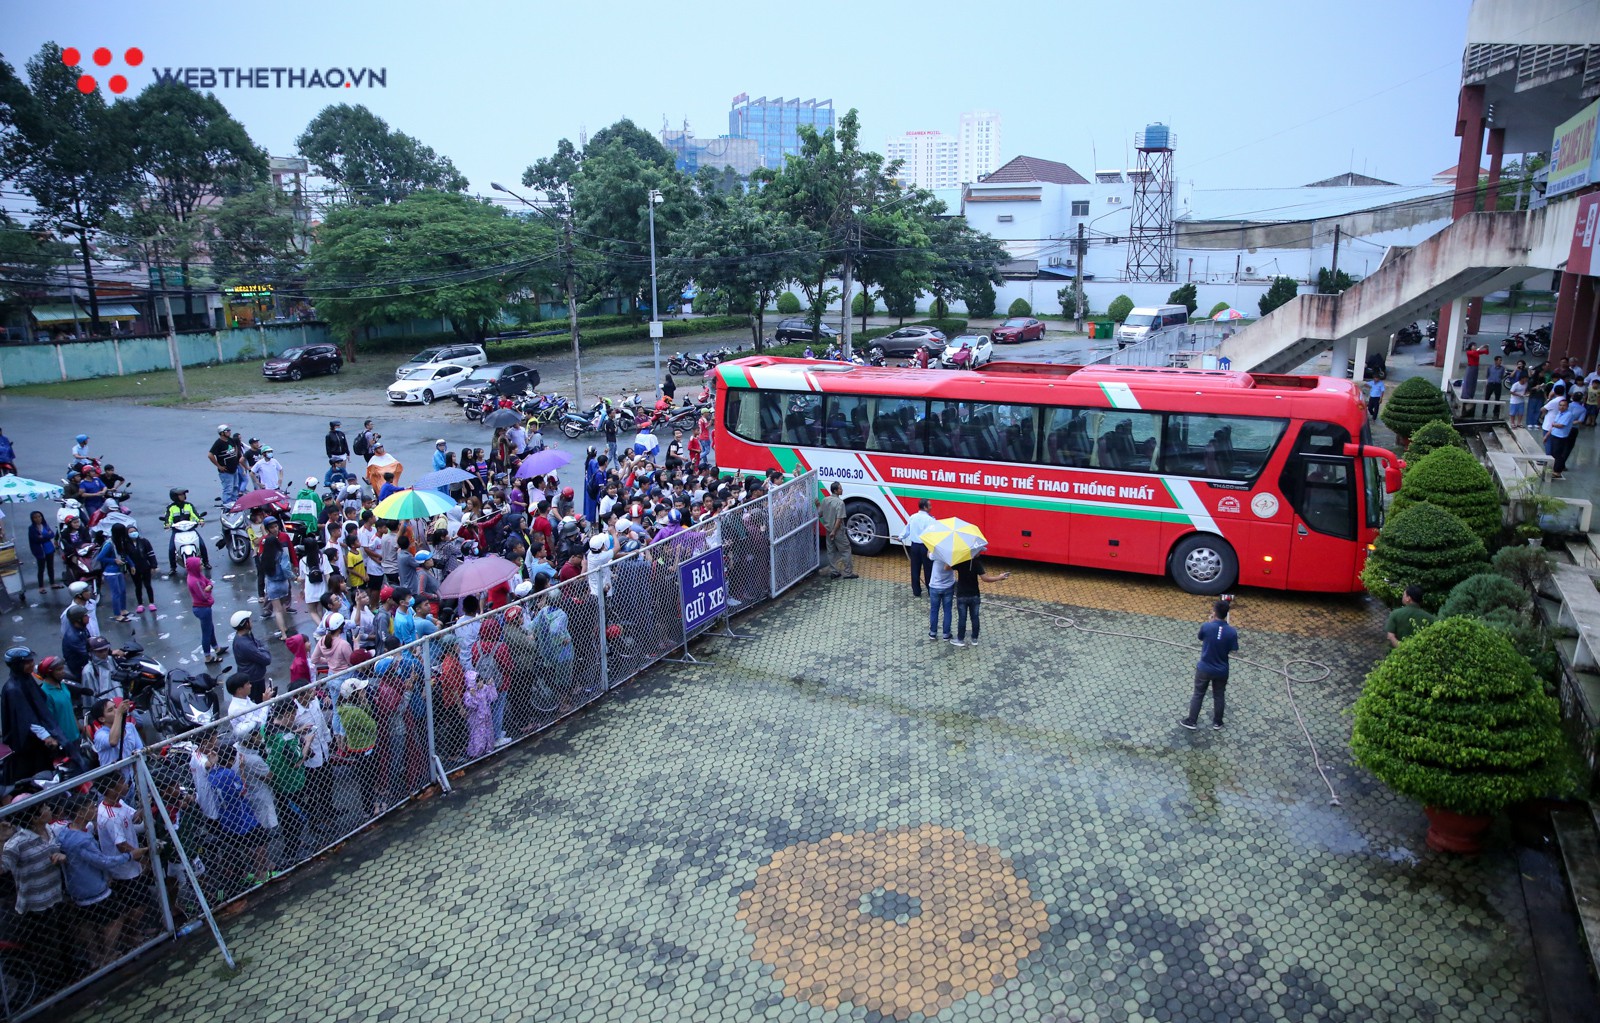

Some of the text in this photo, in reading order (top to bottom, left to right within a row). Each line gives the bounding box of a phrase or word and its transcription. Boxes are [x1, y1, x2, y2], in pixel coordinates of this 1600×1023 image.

[1220, 362, 1229, 370] A1
[819, 466, 864, 480] 50A-006.30
[890, 466, 1155, 500] TRUNG TÂM THỂ DỤC THỂ THAO THỐNG NHẤT
[691, 559, 713, 588] BÃI
[685, 586, 725, 623] GIỮ XE
